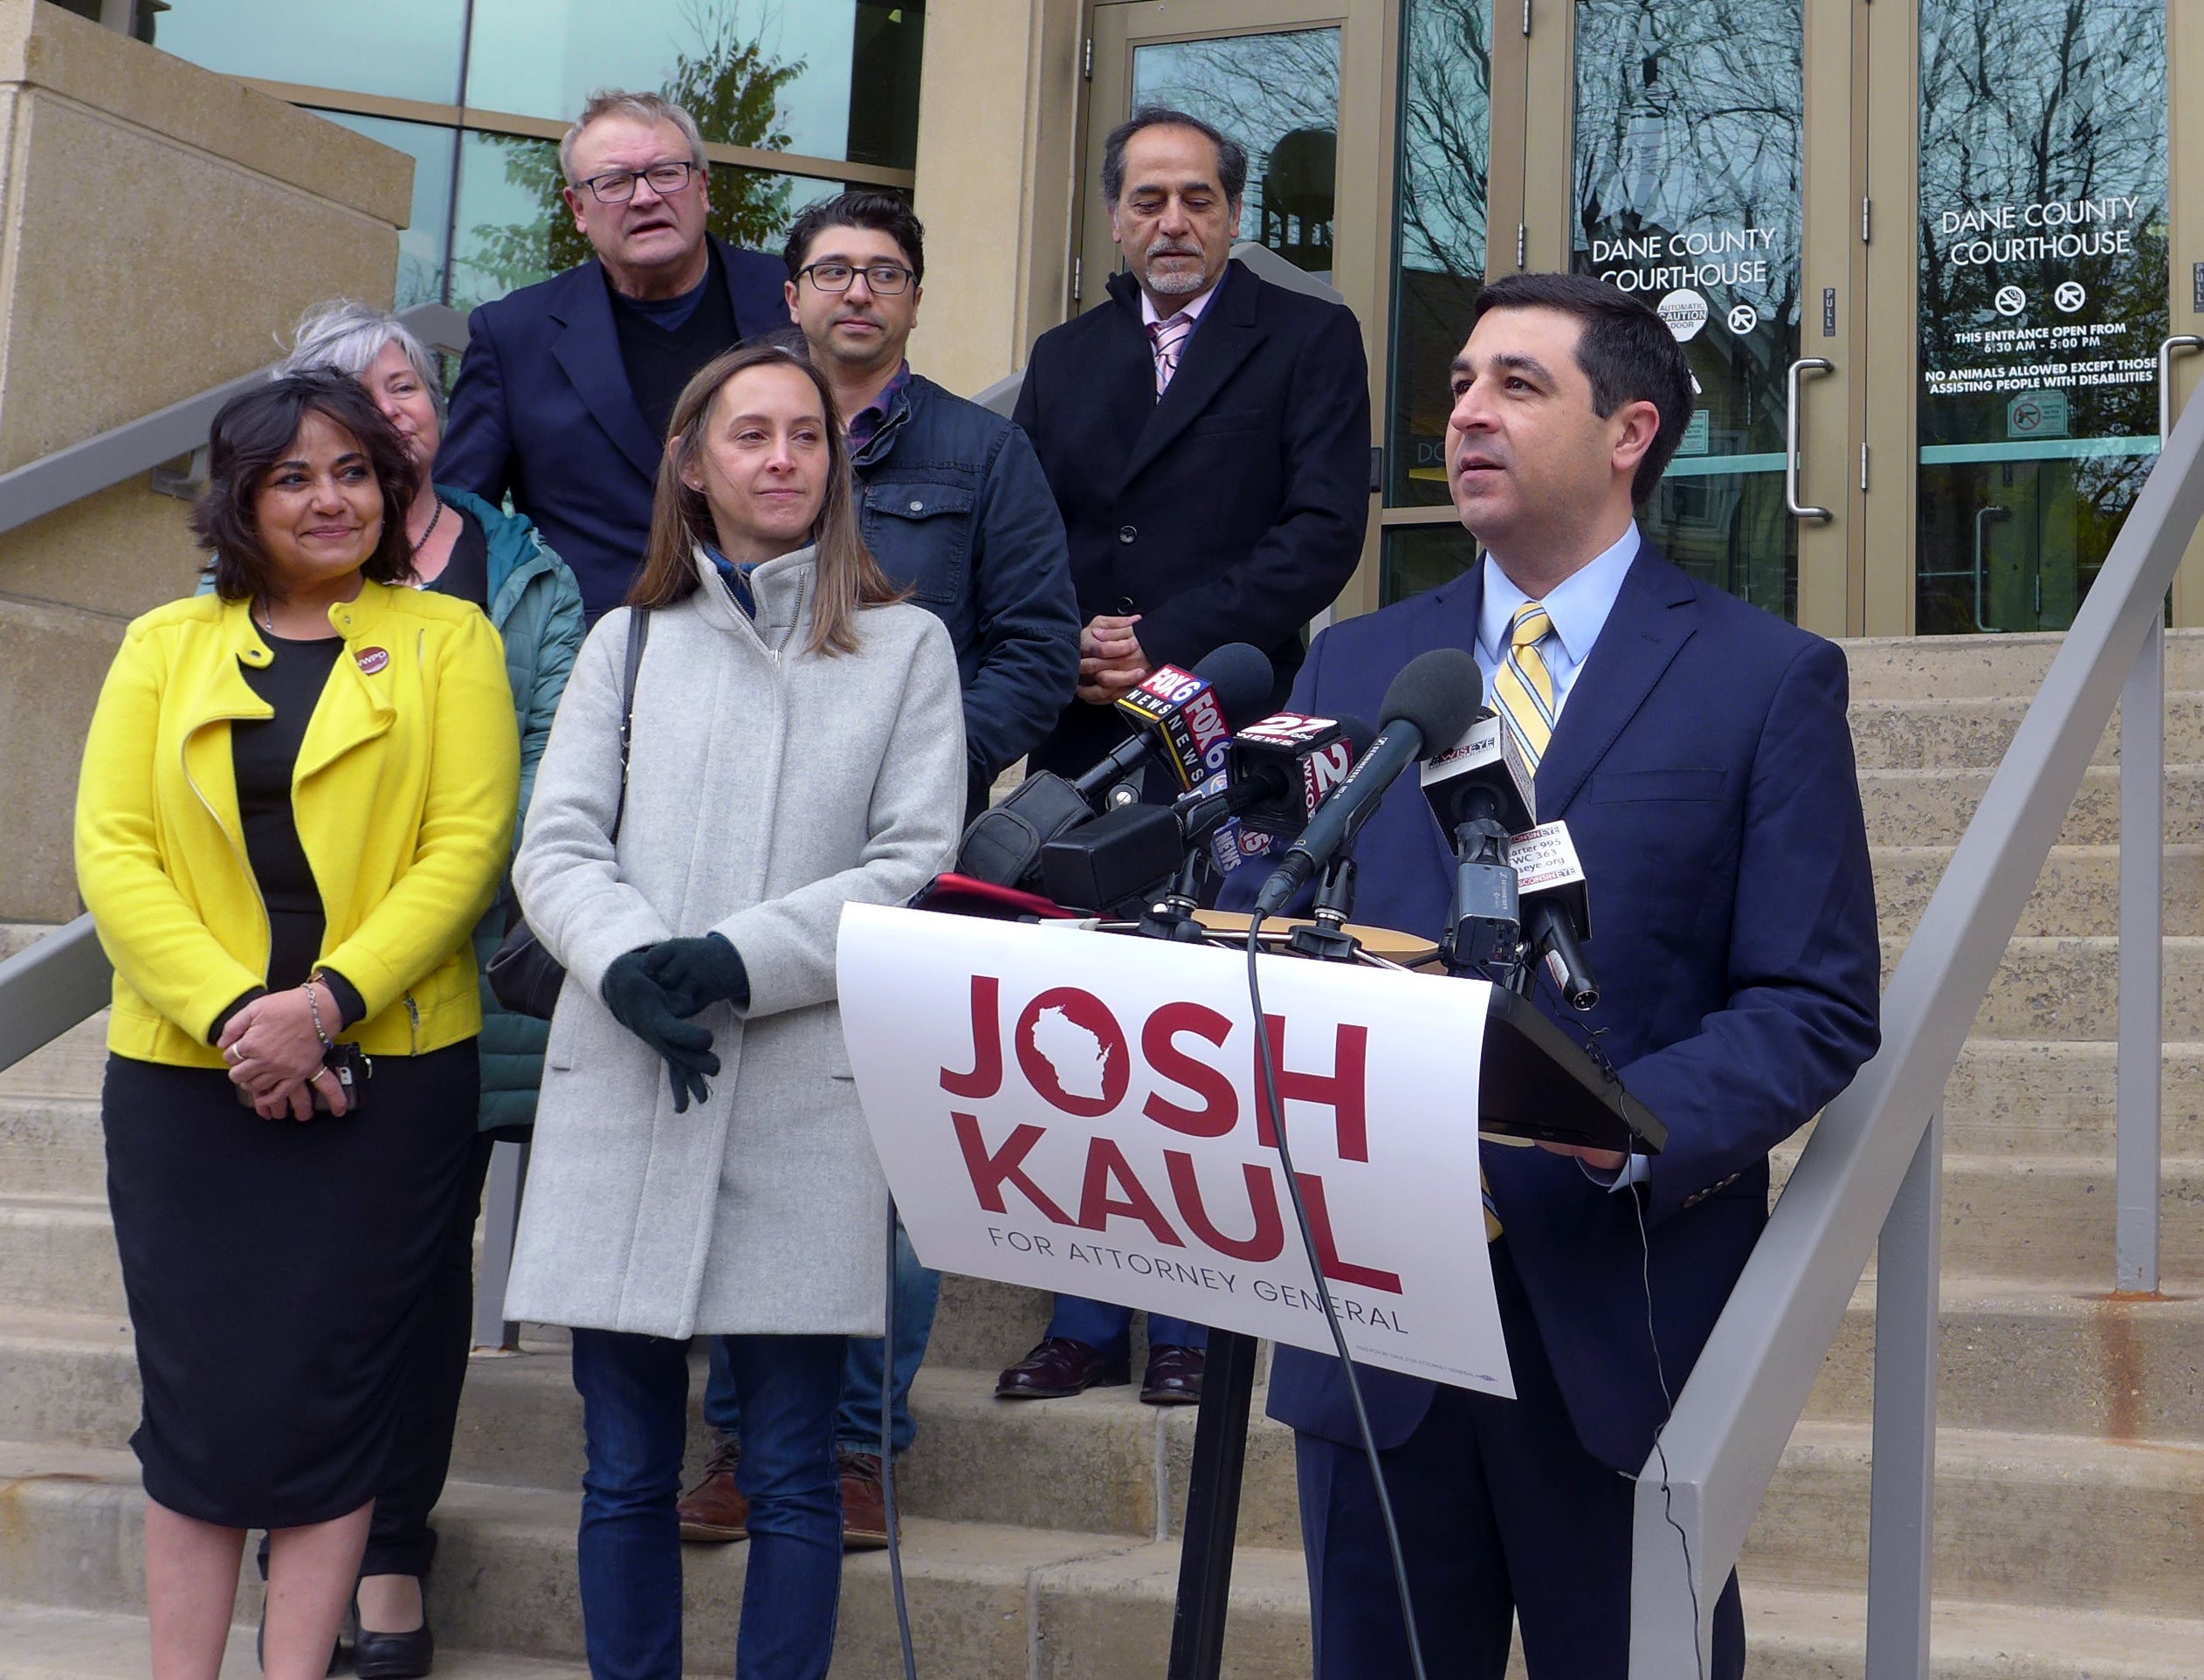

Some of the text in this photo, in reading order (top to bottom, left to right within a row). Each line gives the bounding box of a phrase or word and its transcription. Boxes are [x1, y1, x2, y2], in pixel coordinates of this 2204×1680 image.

[1942, 196, 2139, 233] DANE COUNTY
[1592, 227, 1776, 262] DANE COUNTY
[1950, 230, 2131, 266] COURTHOUSE
[2195, 264, 2204, 303] PULL
[1658, 310, 1706, 322] CAUTION
[1659, 302, 1705, 312] AUTOMATIC
[1670, 321, 1694, 330] DOOR
[1954, 322, 2126, 344] THIS ENTRANCE OPEN FROM
[1984, 341, 2012, 354] 6:30
[2015, 340, 2036, 352] AM
[2049, 338, 2077, 350] 5:00
[2082, 336, 2101, 348] PM
[1925, 357, 2158, 382] NO ANIMALS ALLOWED EXCEPT THOSE
[1929, 370, 2153, 394] ASSISTING PEOPLE WITH DISABILITIES
[1126, 689, 1173, 714] NEWS
[1239, 716, 1339, 736] 27
[1167, 714, 1204, 781] NEWS
[1236, 732, 1294, 747] NEWS
[1312, 743, 1348, 793] 2
[1215, 830, 1242, 871] NEWS
[1243, 831, 1270, 851] 15
[1510, 838, 1561, 857] arter 995
[1517, 857, 1565, 873] seye.org
[1537, 849, 1557, 859] 363
[940, 974, 1368, 1163] JOSH
[950, 1111, 1403, 1295] KAUL
[988, 1227, 1408, 1334] FOR ATTORNEY GENERAL
